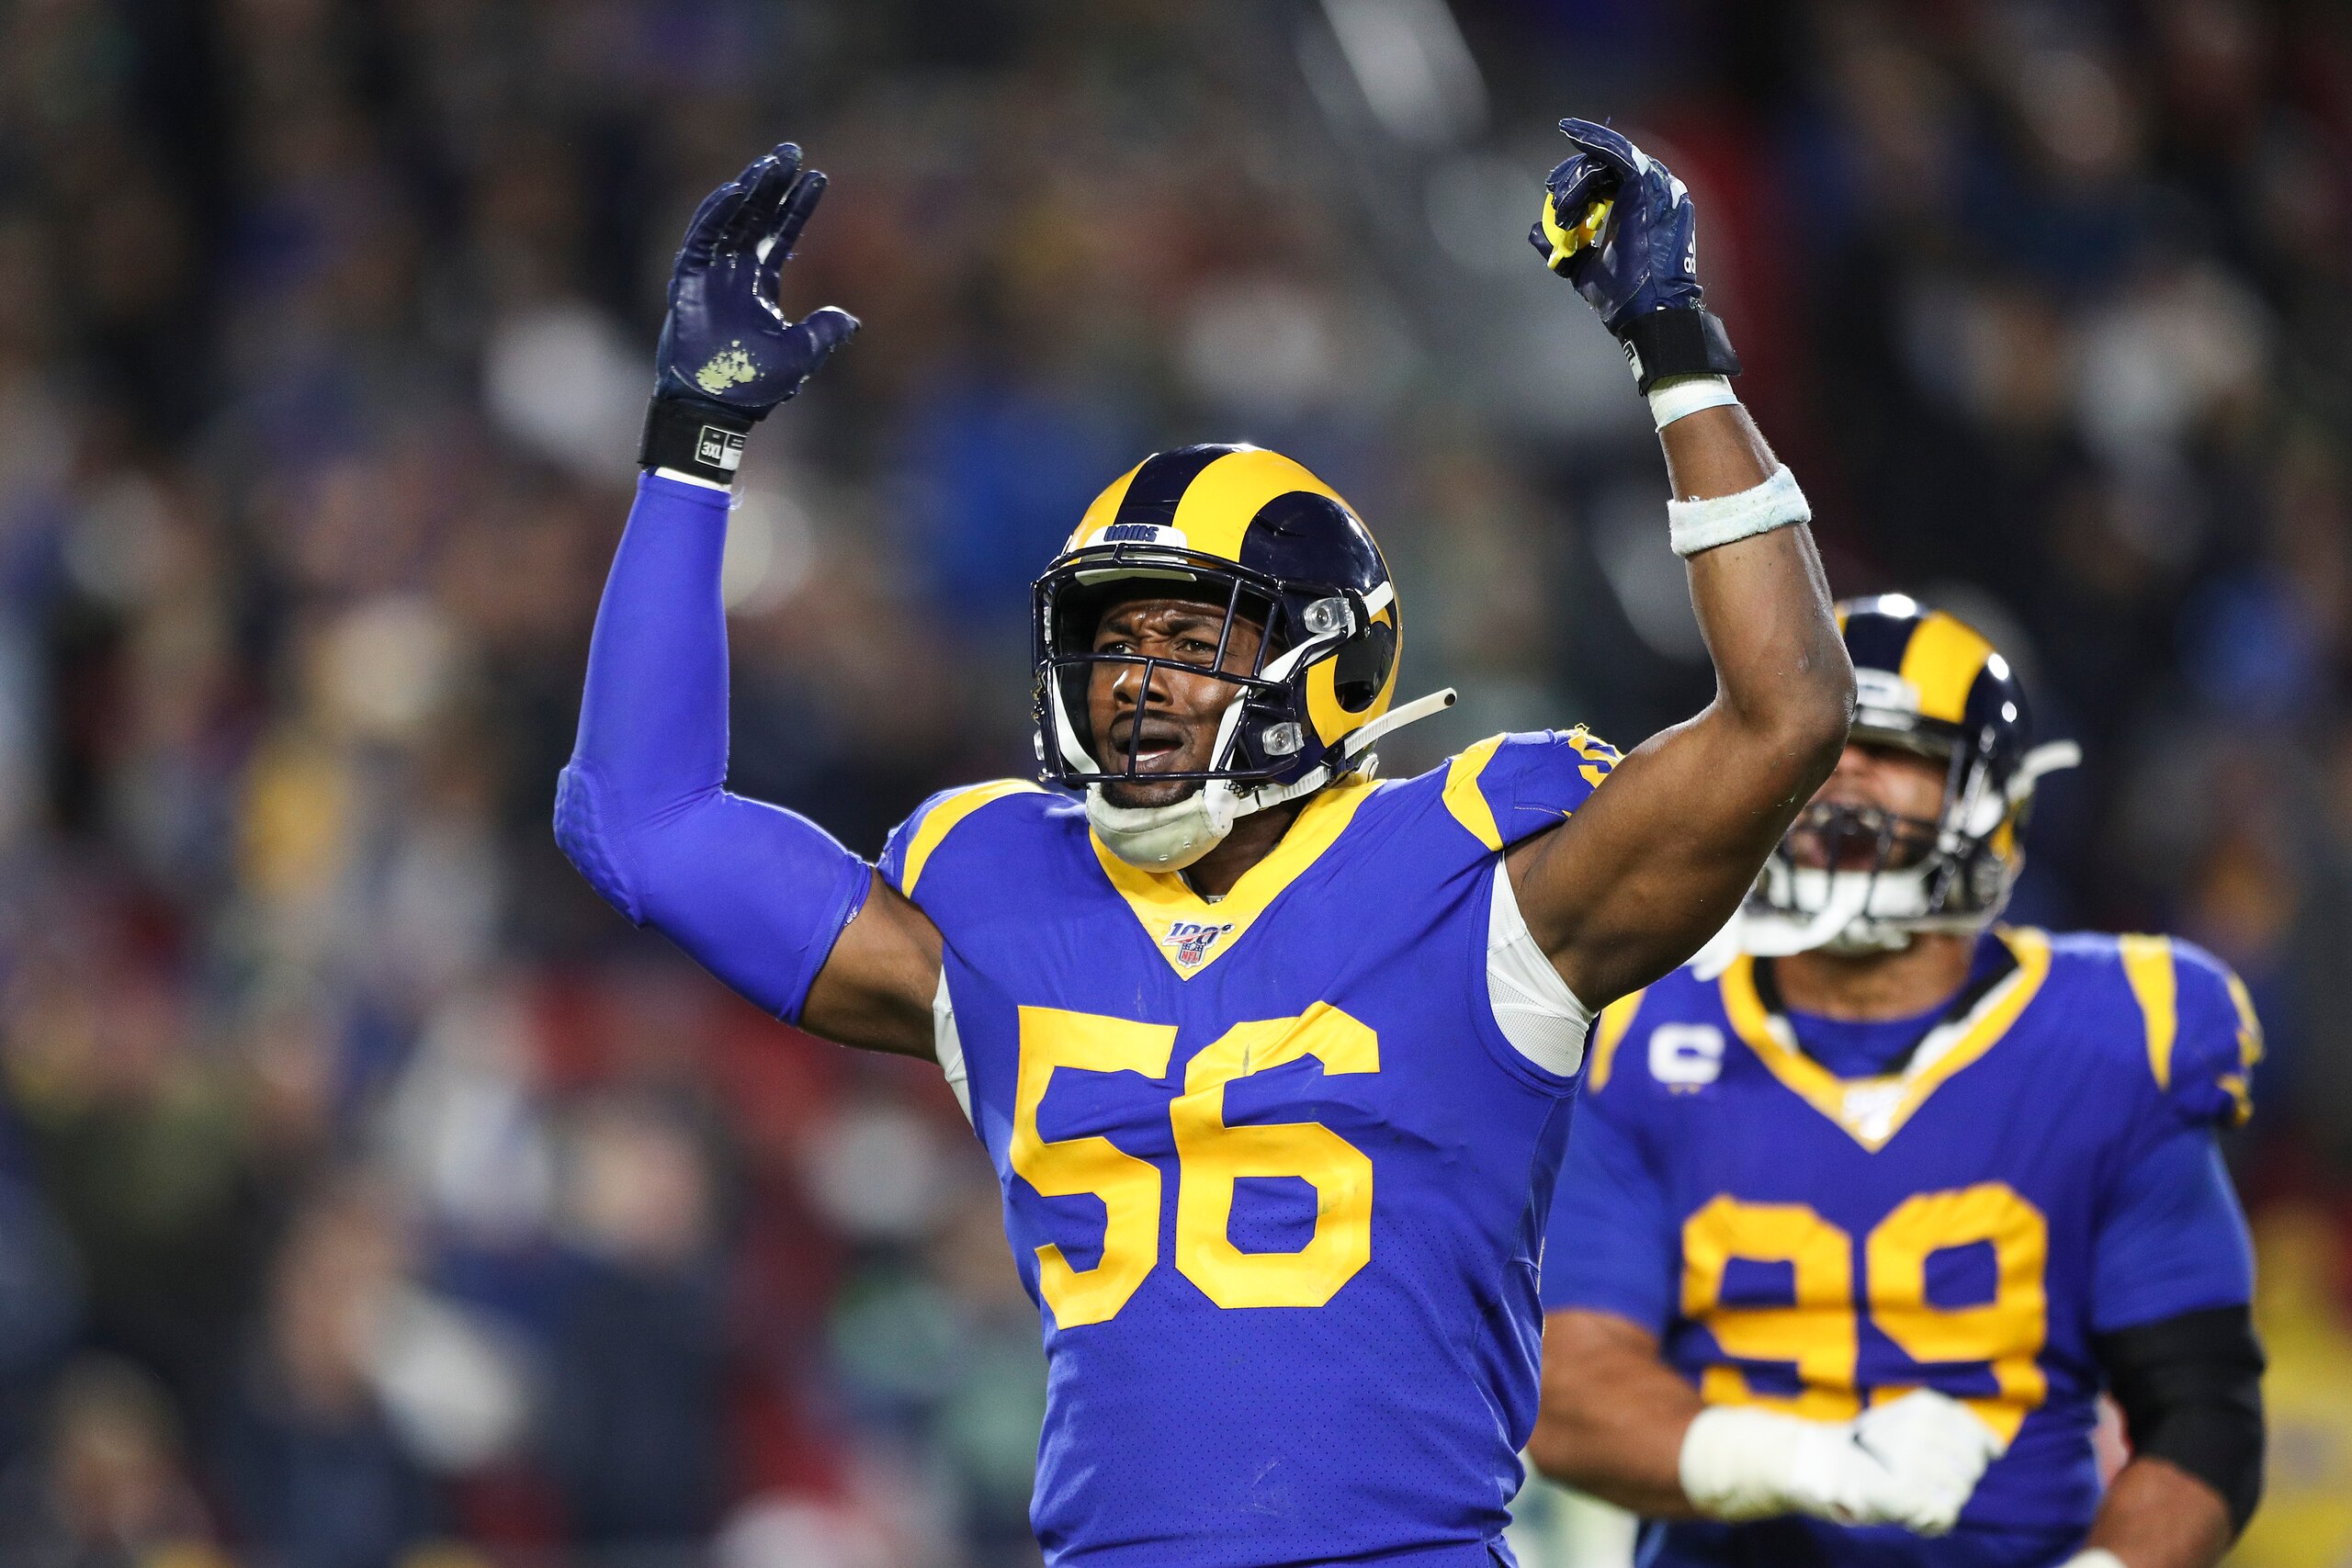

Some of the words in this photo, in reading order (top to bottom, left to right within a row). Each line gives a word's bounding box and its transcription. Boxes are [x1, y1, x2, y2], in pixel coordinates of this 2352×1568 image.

[701, 441, 722, 459] 3XL
[1182, 950, 1200, 962] NFL
[1648, 1022, 1725, 1085] C
[1010, 999, 1381, 1331] 56
[1680, 1180, 2049, 1450] 99
